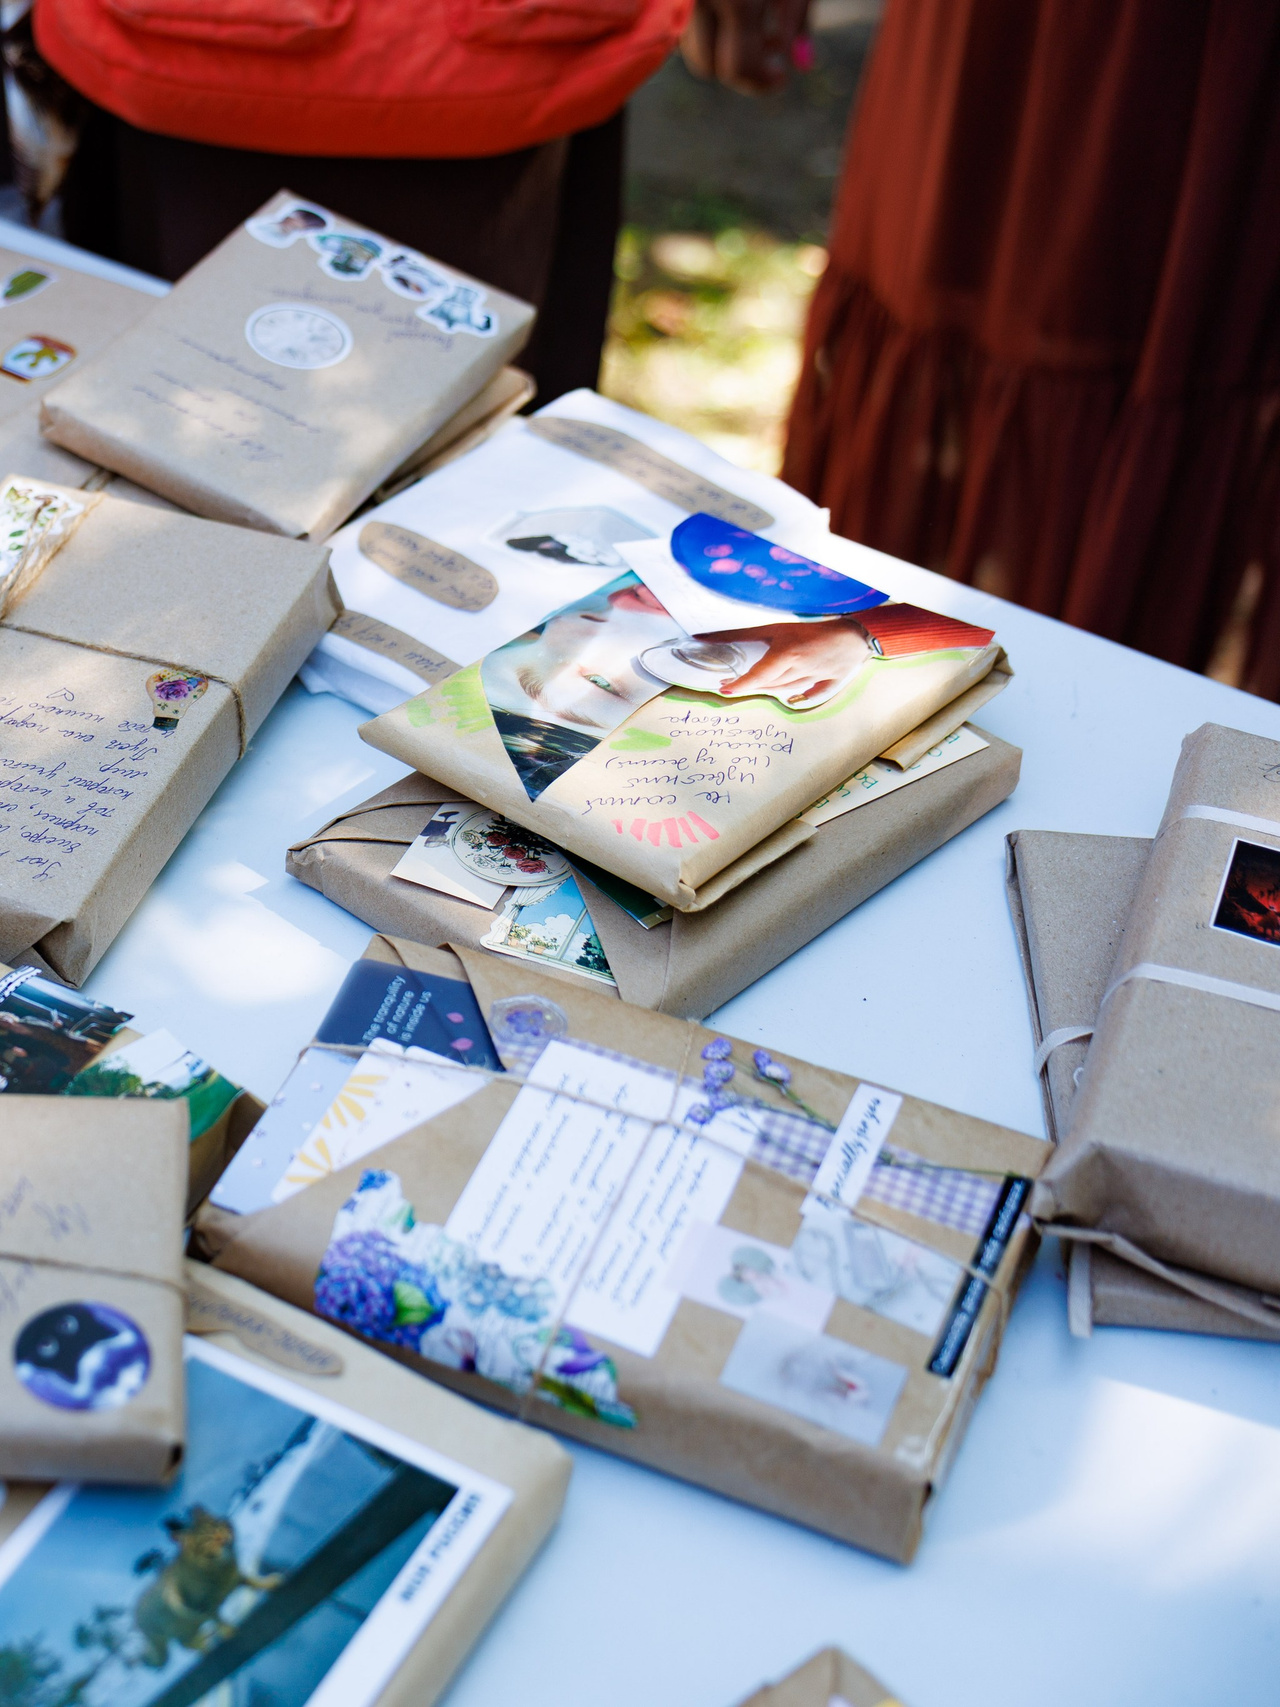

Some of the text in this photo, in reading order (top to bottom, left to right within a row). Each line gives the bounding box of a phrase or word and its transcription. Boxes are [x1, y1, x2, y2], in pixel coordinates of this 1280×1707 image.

[373, 975, 406, 1022] tranquility
[392, 990, 414, 1023] nature
[406, 1005, 425, 1033] inside
[418, 991, 432, 1004] us
